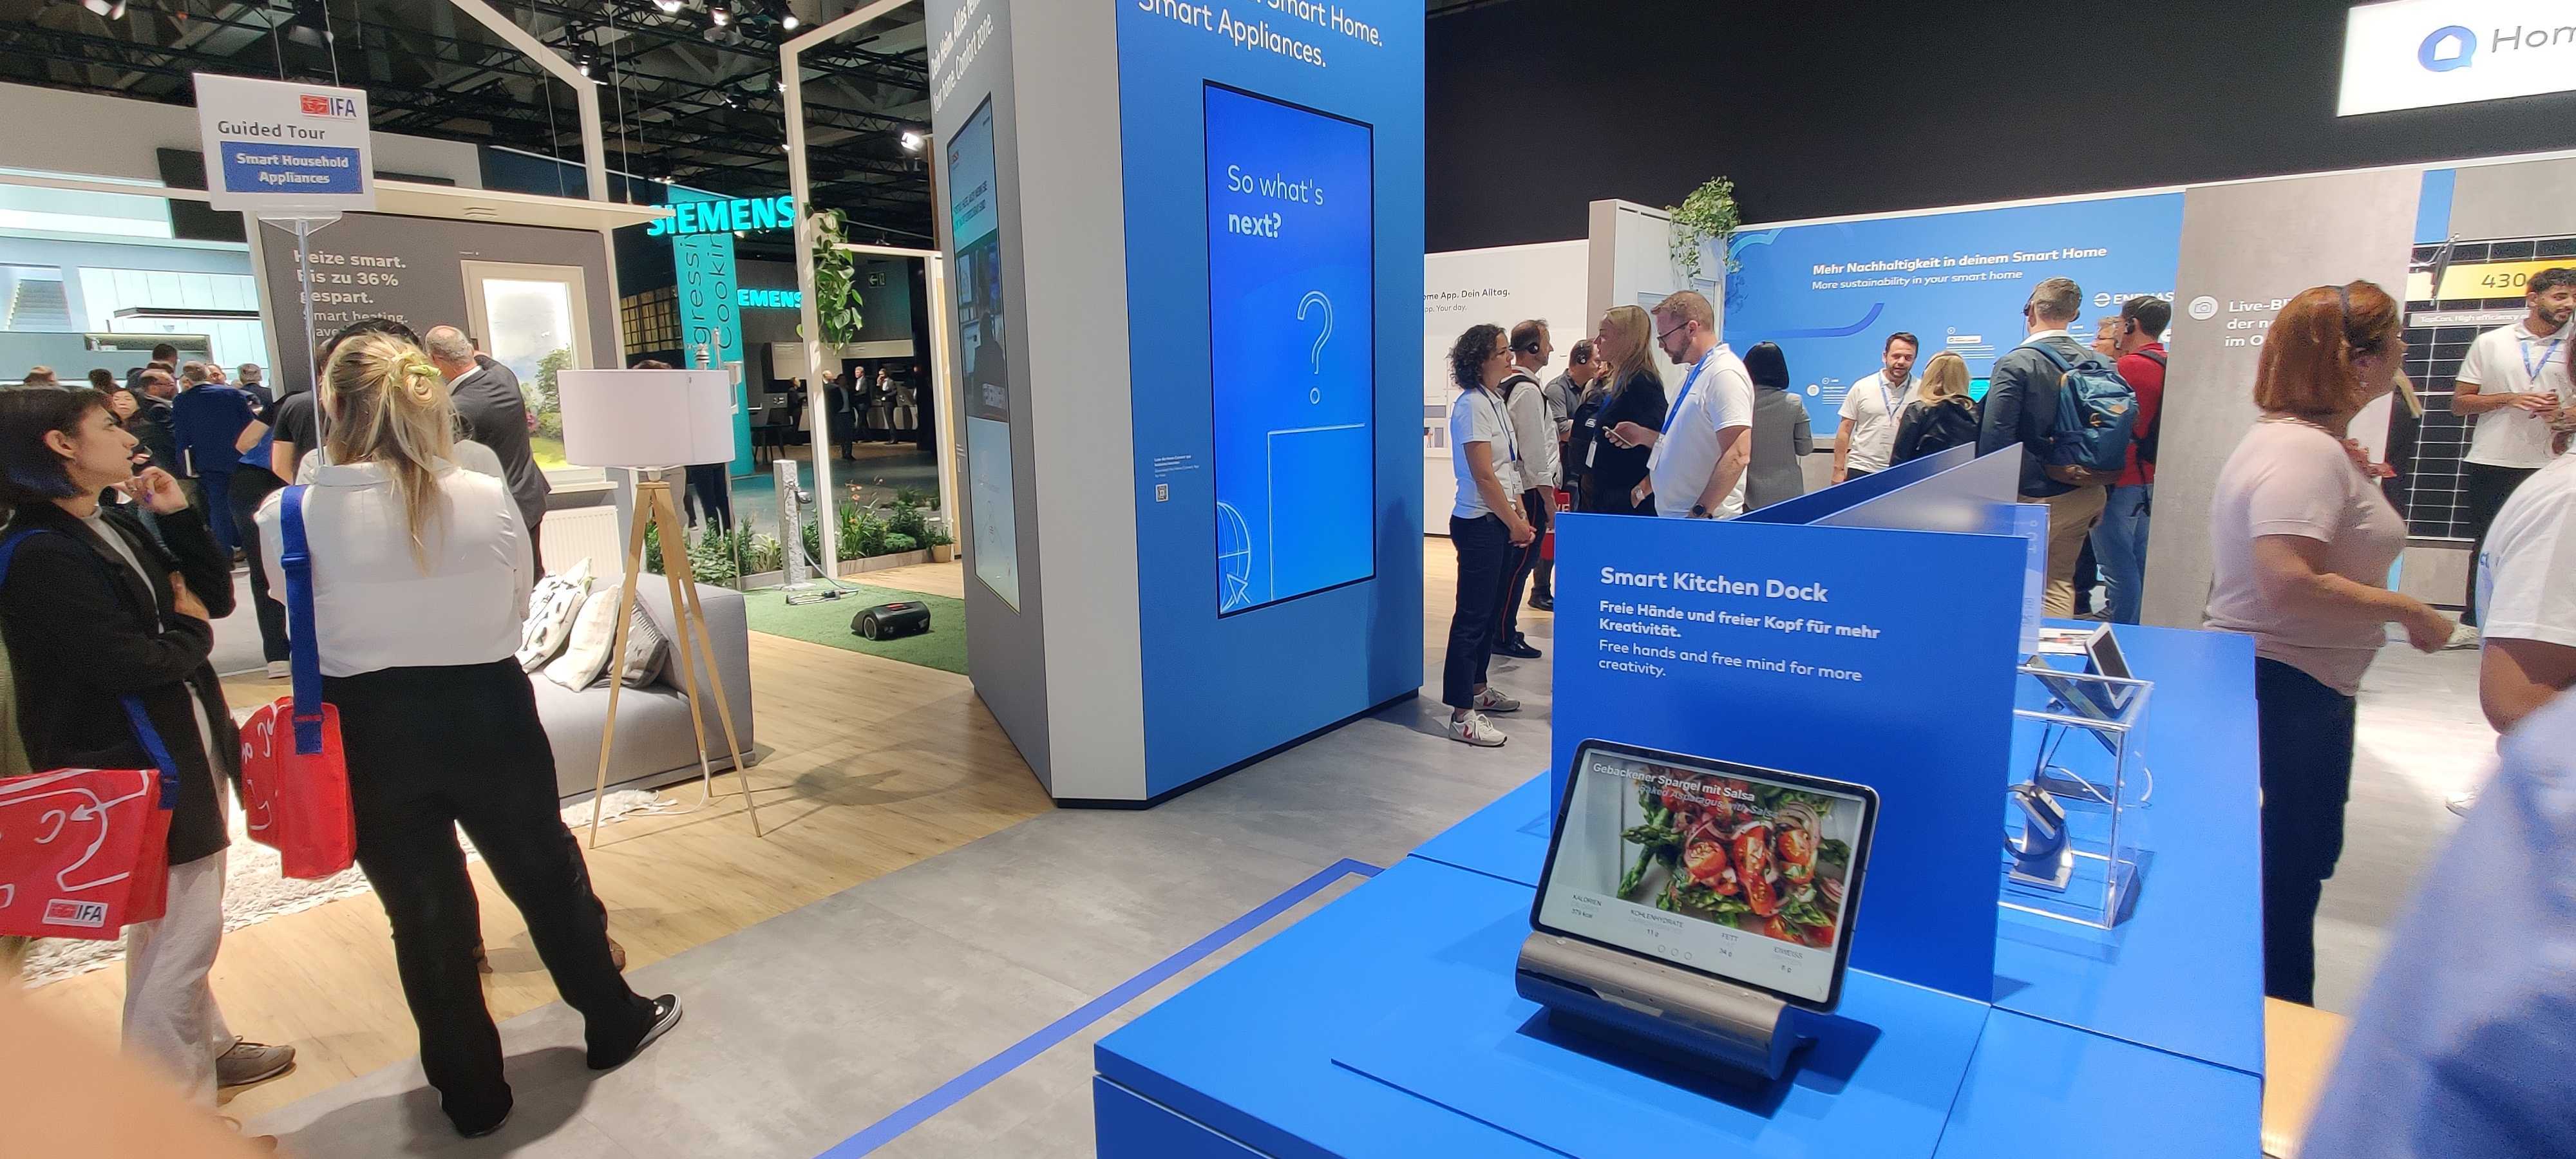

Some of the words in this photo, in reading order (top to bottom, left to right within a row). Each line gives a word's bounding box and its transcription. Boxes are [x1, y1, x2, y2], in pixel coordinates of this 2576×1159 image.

[976, 14, 994, 50] zone.
[1331, 5, 1383, 46] Home.
[1218, 8, 1326, 68] Appliances.
[330, 97, 357, 117] IFA
[218, 120, 281, 137] Guided
[287, 125, 325, 140] Tour
[236, 153, 279, 165] Smart
[282, 154, 349, 168] Household
[259, 171, 330, 185] Appliances
[1227, 164, 1254, 194] So
[1259, 173, 1324, 205] what's
[647, 196, 796, 236] SIEMENS
[1228, 212, 1282, 238] next?
[350, 254, 406, 269] smart.
[1813, 263, 1844, 276] Mehr
[1846, 258, 1940, 273] Nachhaltigkeit
[1943, 256, 1955, 267] in
[1958, 252, 2009, 267] deinem
[2012, 249, 2059, 263] Smart
[2062, 247, 2108, 259] Home
[331, 274, 351, 284] zu
[1812, 281, 1838, 290] More
[1840, 276, 1909, 288] sustainability
[1912, 276, 1922, 285] in
[1924, 275, 1949, 286] your
[1951, 273, 1987, 283] smart
[1989, 270, 2023, 280] home
[2481, 272, 2526, 288] 430
[680, 234, 712, 345] gressi
[707, 233, 732, 349] Cookin
[737, 288, 802, 308] EMENS
[1441, 291, 1459, 301] App.
[1461, 290, 1480, 298] Dein
[1482, 288, 1510, 297] Alltag.
[2113, 292, 2174, 305] ENAS
[1453, 304, 1468, 312] day.
[2226, 318, 2255, 330] der
[2225, 335, 2246, 346] im
[1600, 567, 1668, 589] Smart
[1673, 571, 1759, 596] Kitchen
[1765, 579, 1829, 603] Dock
[1599, 618, 1681, 638] Kreativität.
[1600, 600, 1634, 615] Freie
[1637, 603, 1684, 619] Hände
[1687, 610, 1715, 623] und
[1718, 610, 1761, 628] freier
[1764, 616, 1804, 633] Kopf
[1806, 619, 1832, 635] für
[1835, 624, 1880, 639] mehr
[1598, 657, 1667, 678] creativity.
[1599, 639, 1629, 654] Free
[1633, 643, 1676, 659] hands
[1680, 648, 1708, 663] and
[1711, 651, 1742, 666] free
[1746, 656, 1786, 673] mind
[1789, 661, 1815, 675] for
[1818, 666, 1862, 682] more
[1593, 762, 1657, 783] Gebackener
[1658, 775, 1701, 792] Spargel
[1702, 785, 1721, 795] mit
[1723, 787, 1755, 802] Salsa
[1639, 784, 1670, 796] Baked
[1671, 789, 1722, 807] Asparagus
[75, 904, 102, 921] IFA
